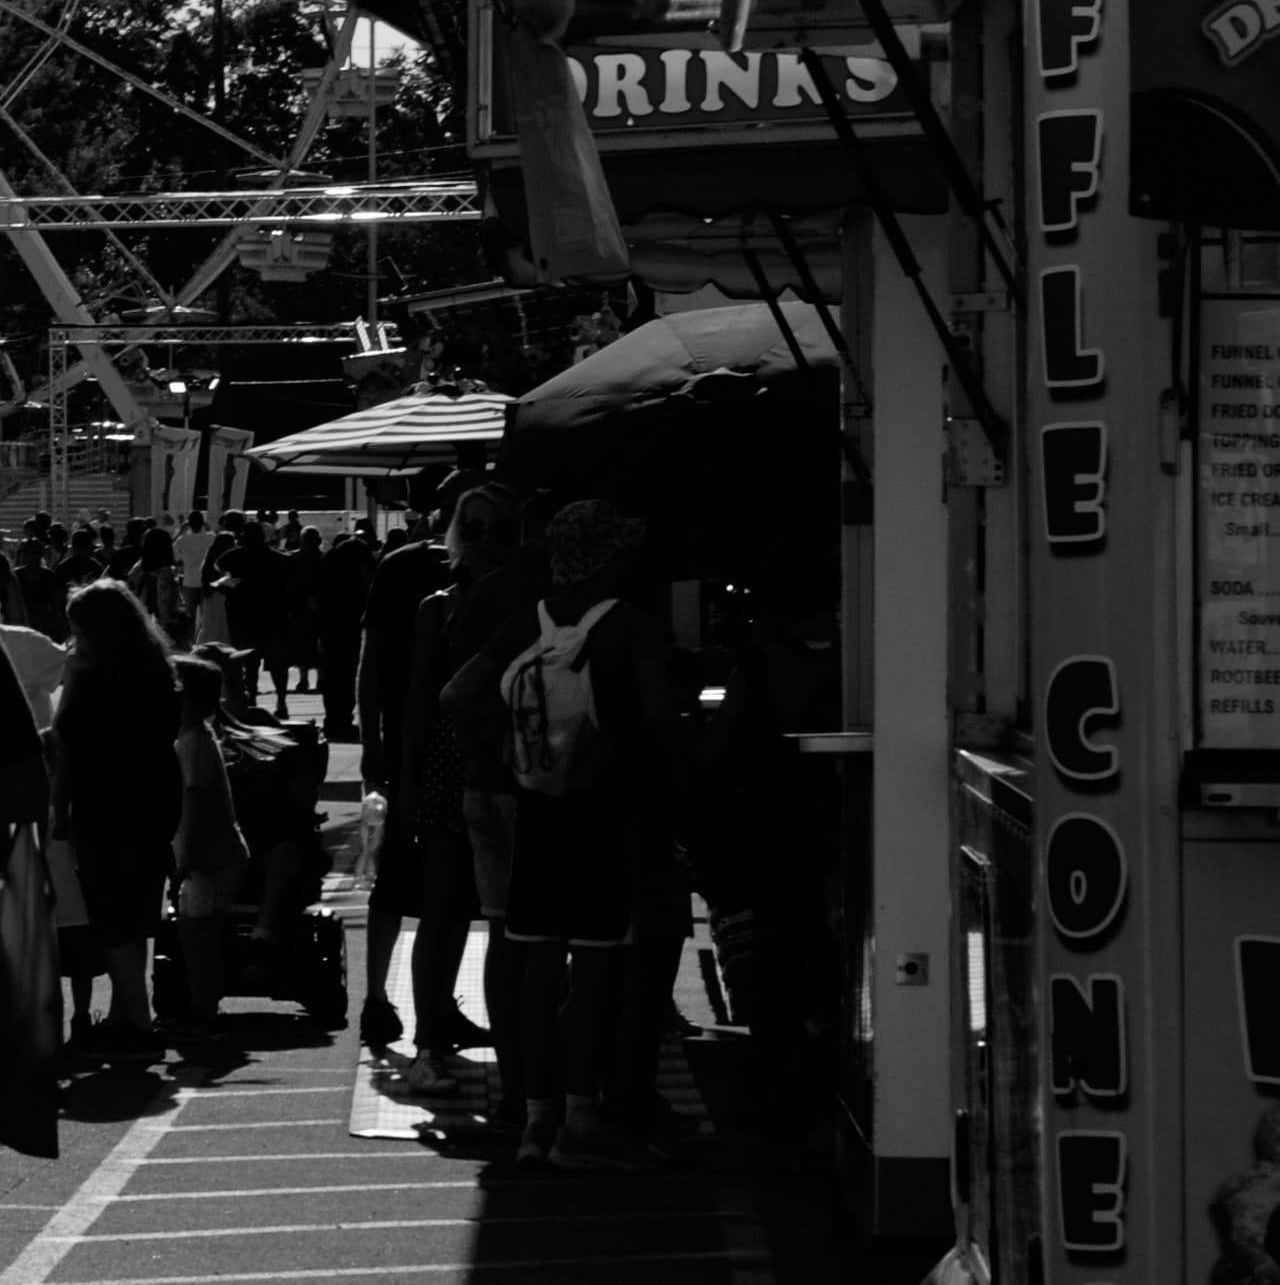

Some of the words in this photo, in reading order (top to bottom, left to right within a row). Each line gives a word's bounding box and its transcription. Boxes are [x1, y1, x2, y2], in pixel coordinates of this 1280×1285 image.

[1212, 404, 1257, 419] FRIED
[1211, 581, 1254, 595] SODA
[1209, 640, 1267, 655] WATER
[1210, 699, 1274, 714] REFILLS
[1045, 655, 1130, 1285] CONE
